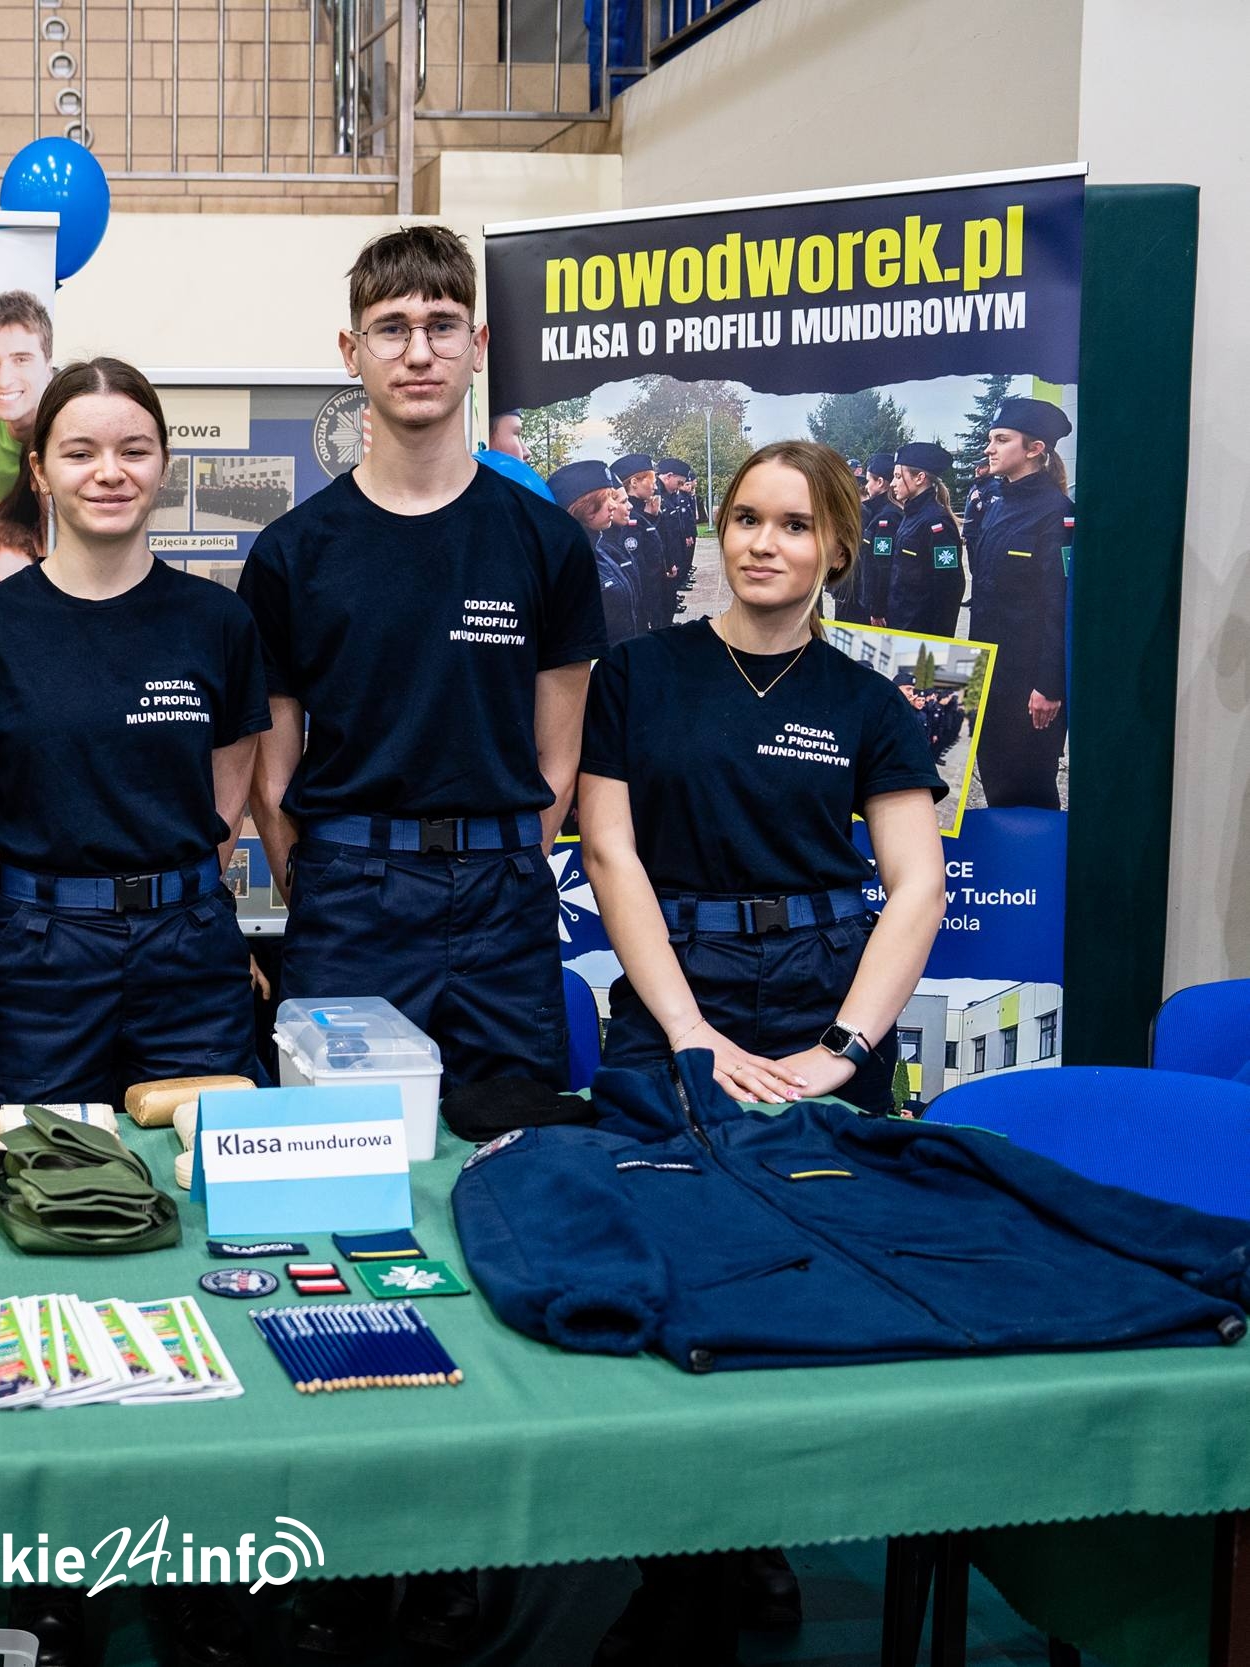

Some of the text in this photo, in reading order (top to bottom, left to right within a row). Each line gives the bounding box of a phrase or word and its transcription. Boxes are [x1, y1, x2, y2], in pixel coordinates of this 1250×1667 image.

[545, 205, 1024, 313] nowodworek.pl
[541, 291, 1026, 362] KLASA O PROFILU MUNDUROWYM
[168, 425, 221, 438] rowa
[318, 389, 367, 461] ODDZIAŁ O PROFIL
[150, 537, 234, 547] Zajęcia z policją
[464, 599, 516, 612] ODDZIAŁ
[466, 615, 518, 629] PROFILU
[145, 680, 196, 691] ODDZIAŁ
[140, 695, 201, 707] O PROFILU
[126, 711, 210, 725] MUNDUROWYM
[784, 723, 836, 741] ODDZIAŁ
[775, 734, 839, 753] O PROFILU
[757, 744, 850, 768] MUNDUROWYM
[945, 861, 974, 878] CE
[961, 888, 1037, 905] Tucholi
[217, 1133, 392, 1156] Klasa mundurowa
